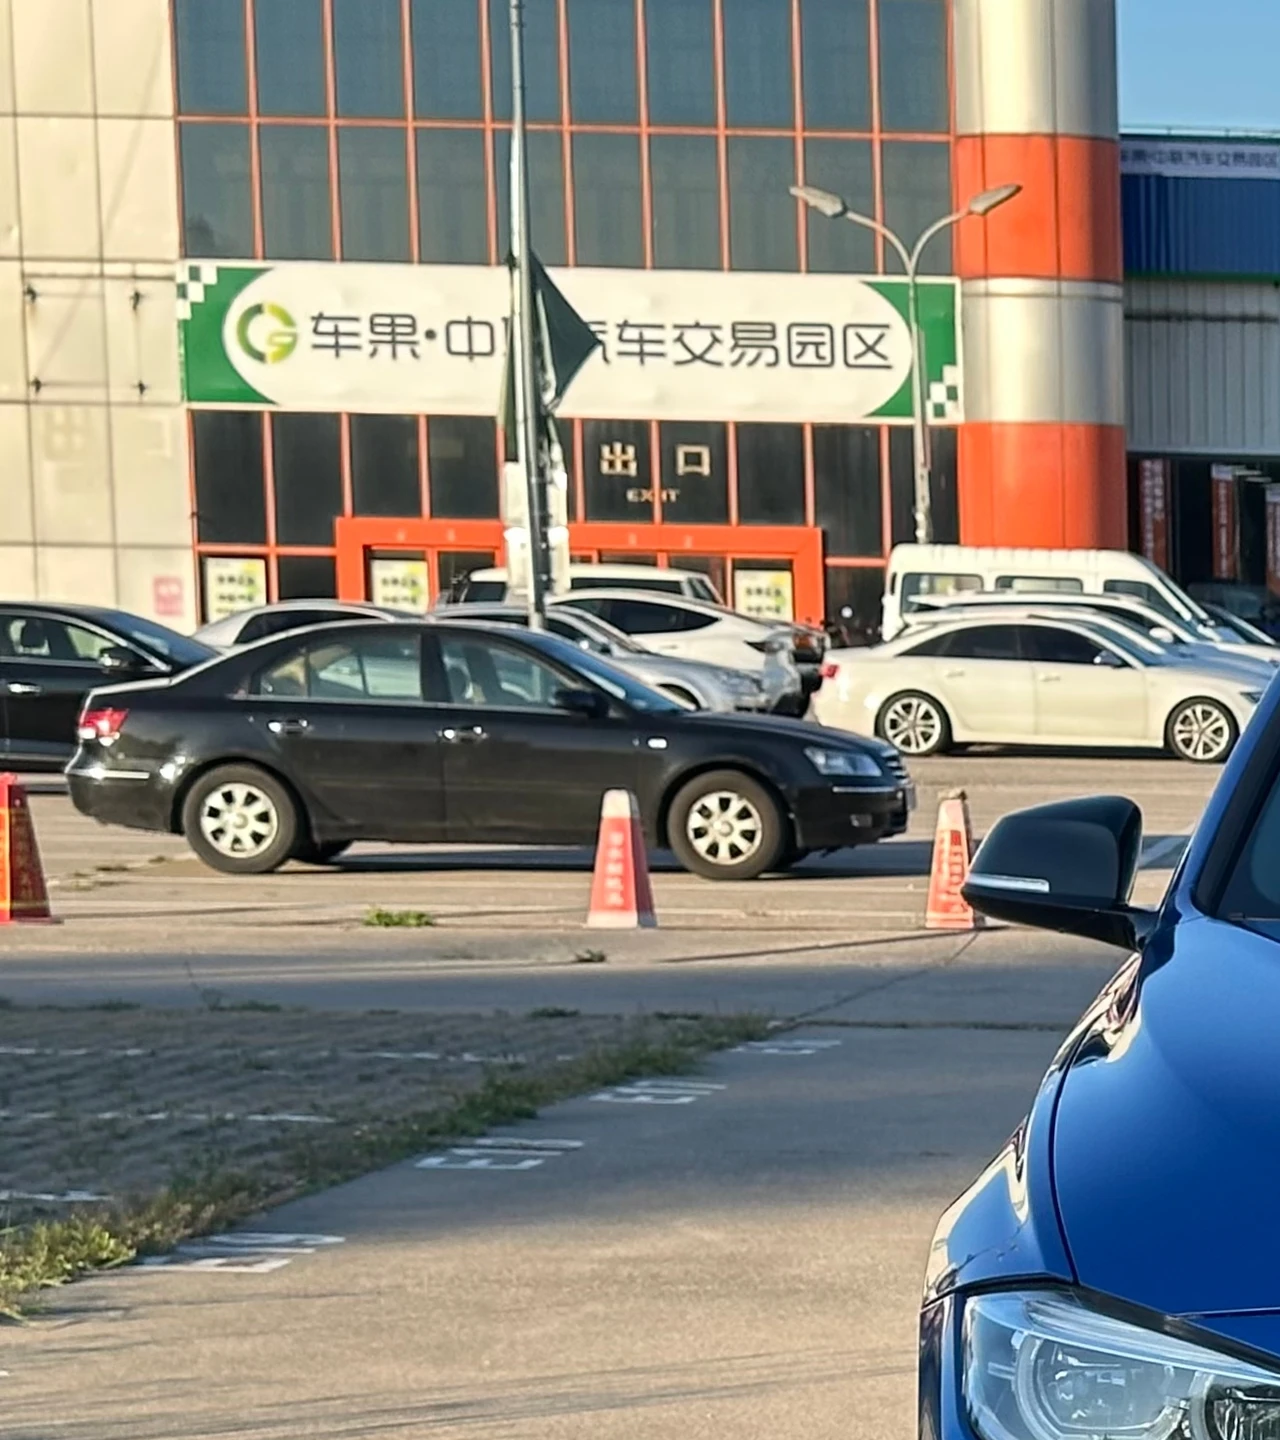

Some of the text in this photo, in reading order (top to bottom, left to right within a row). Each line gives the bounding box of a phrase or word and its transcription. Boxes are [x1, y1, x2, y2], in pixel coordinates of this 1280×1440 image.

[310, 312, 893, 370] 车果·中车交易园区
[601, 441, 710, 477] 出口
[626, 488, 680, 502] EXIT
